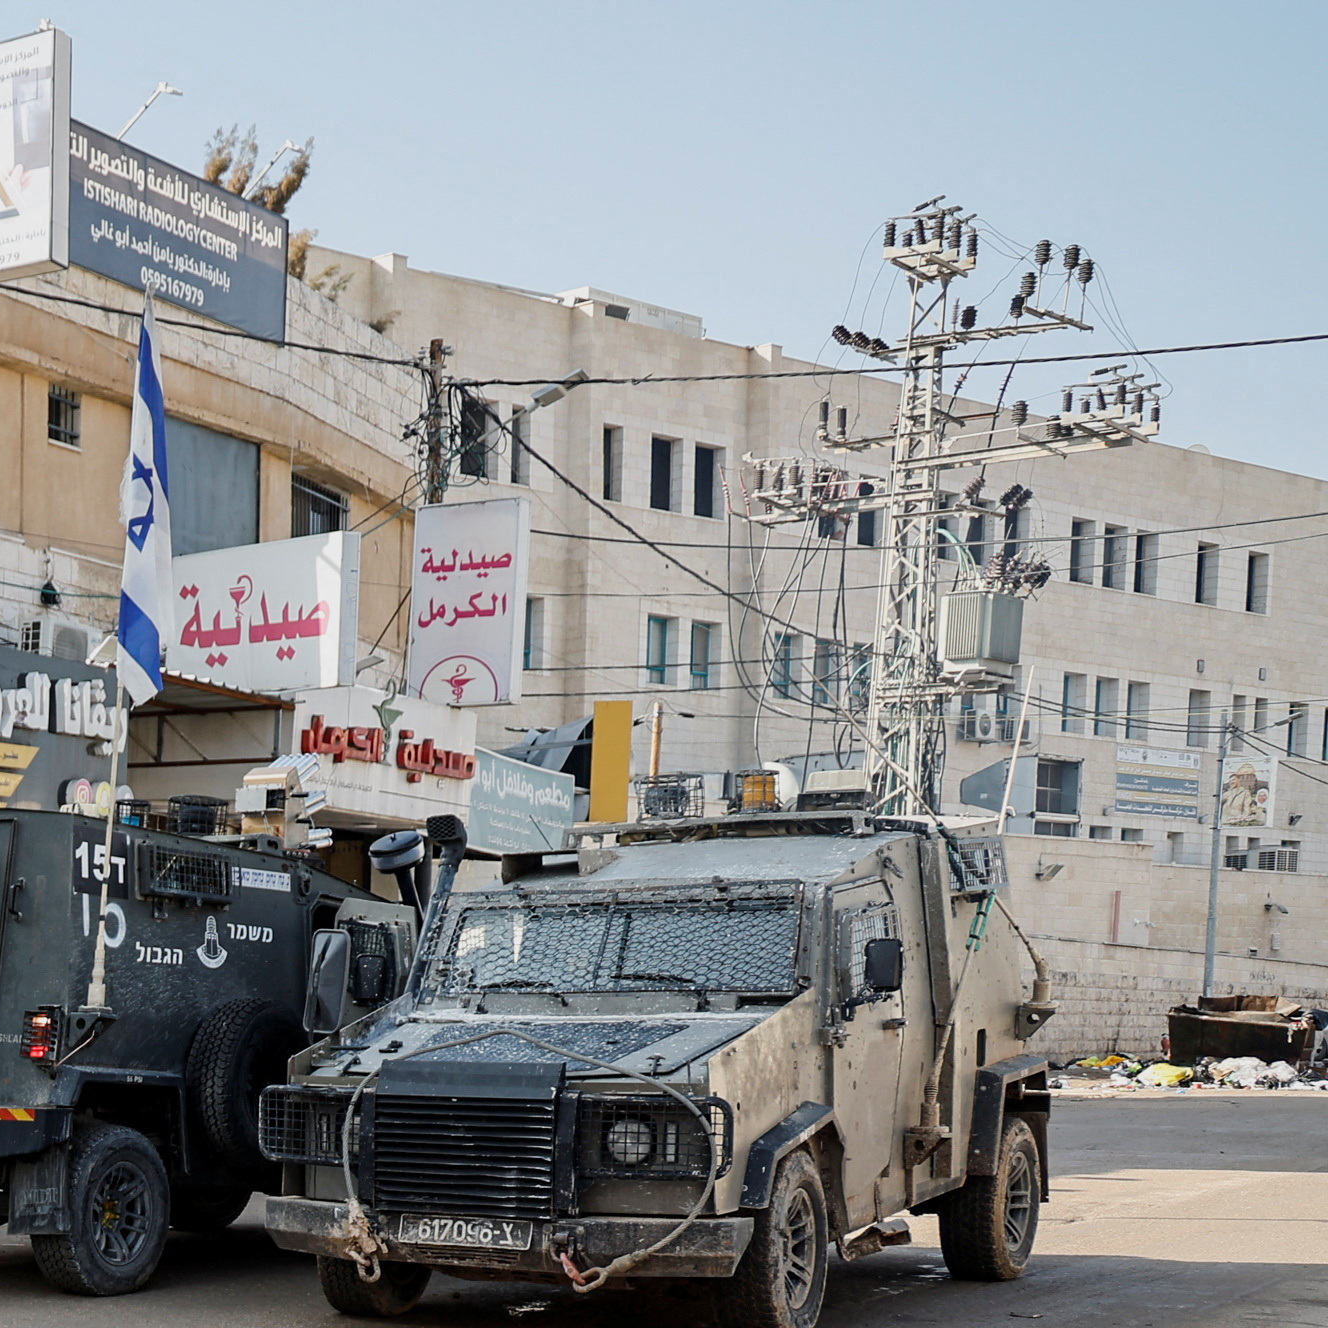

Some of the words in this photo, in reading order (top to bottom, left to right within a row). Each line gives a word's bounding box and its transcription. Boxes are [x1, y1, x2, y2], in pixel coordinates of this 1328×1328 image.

[89, 147, 146, 190] والتصوير
[84, 178, 137, 218] ISTISHARI
[147, 167, 189, 205] للأشعة
[91, 220, 114, 243] غالي
[115, 225, 129, 250] أبو
[131, 235, 152, 258] أحمد
[252, 216, 282, 249] المركز
[141, 266, 204, 306] 0595167979
[418, 547, 512, 582] صيدلية
[418, 592, 507, 628] الكرمل
[302, 714, 384, 763] الكرمل
[482, 759, 495, 793] أبو
[497, 769, 534, 805] وفلافل
[535, 782, 571, 811] مطعم
[227, 923, 273, 943] משמר
[135, 941, 183, 965] הגבול
